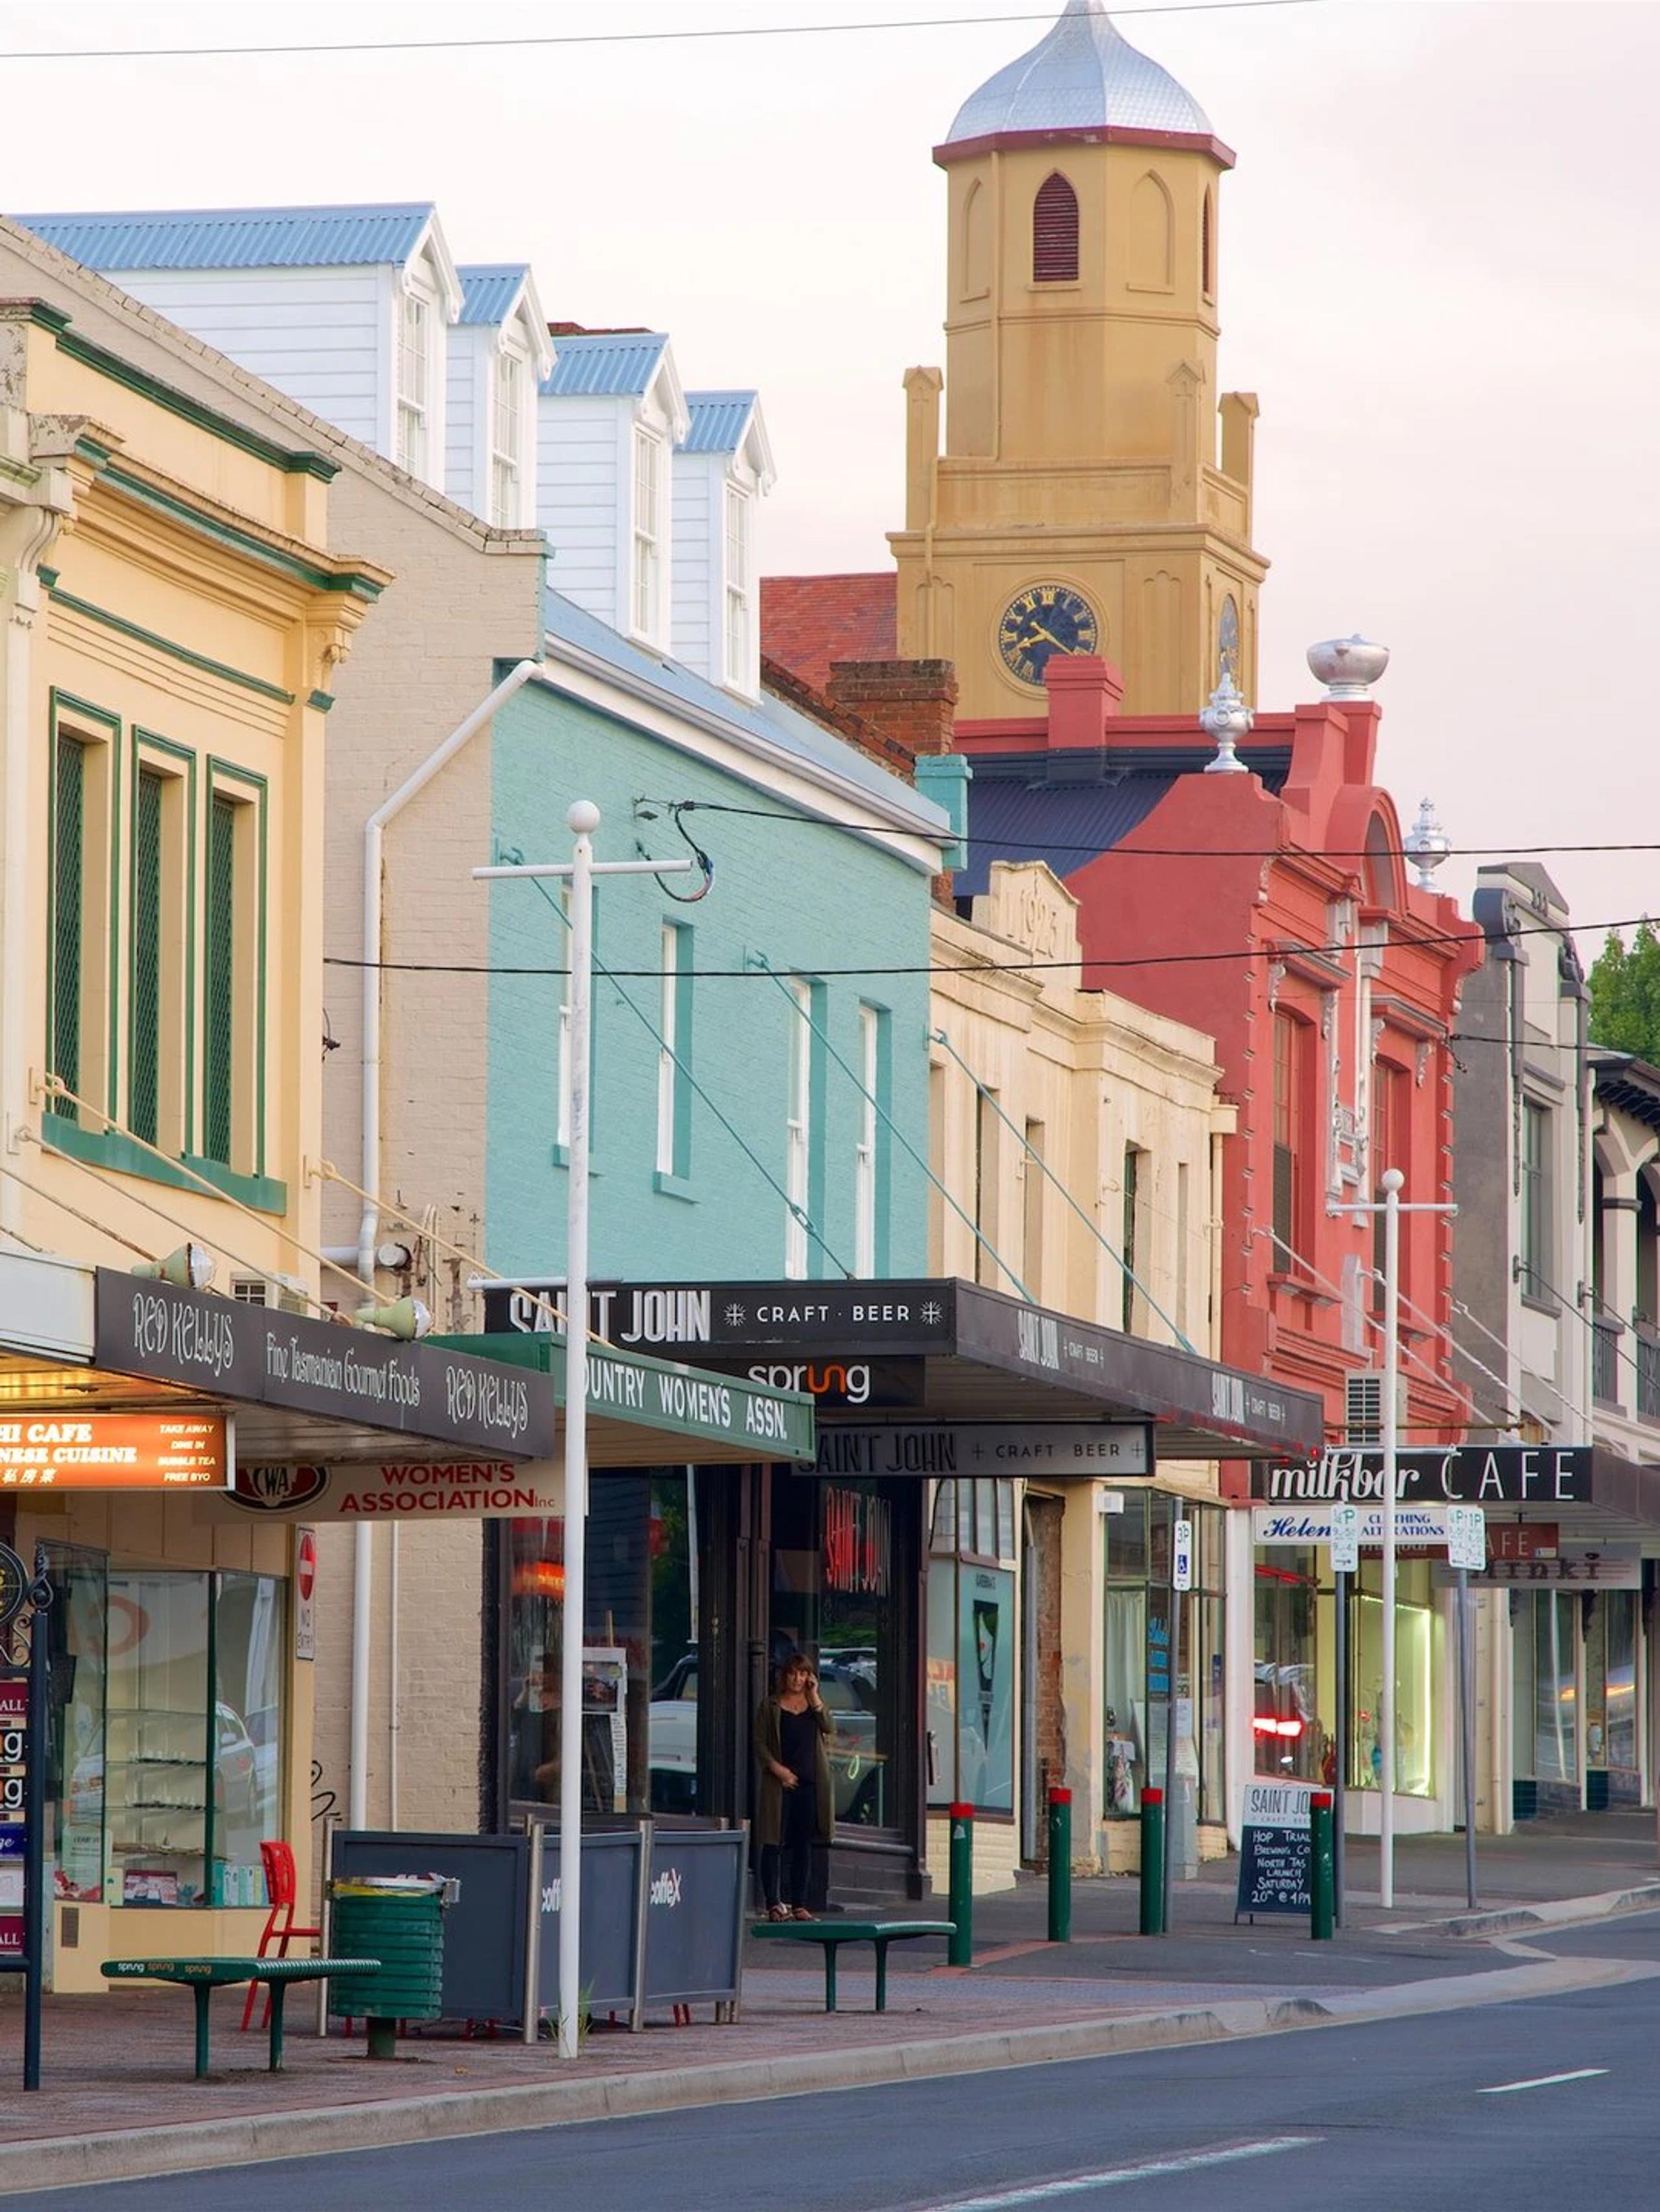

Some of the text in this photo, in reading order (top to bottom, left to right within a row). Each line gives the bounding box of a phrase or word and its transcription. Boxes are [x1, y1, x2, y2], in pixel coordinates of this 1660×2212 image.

[510, 1290, 710, 1342] SAIT JOHN
[756, 1304, 910, 1323] CRAFT BEER
[290, 1335, 342, 1391] Tasmanian
[388, 1358, 421, 1407] Foods
[748, 1364, 870, 1404] sprung
[658, 1373, 731, 1428] WOMEN'S
[27, 1424, 92, 1442] CAFE
[185, 1424, 215, 1434] AWAY
[53, 1447, 137, 1463] CUISINE
[798, 1432, 958, 1473] AINT JOHN
[995, 1443, 1120, 1459] CRAFT BEER
[381, 1463, 515, 1485] WOMEN'S
[1441, 1451, 1576, 1499] CAFE
[338, 1488, 555, 1512] ASSOCIATION Inc
[1369, 1514, 1430, 1524] CLTHING
[1362, 1525, 1445, 1535] ALTRATIONS
[1251, 1788, 1310, 1815] SAINT JO
[1252, 1830, 1274, 1843] HOP
[1256, 1876, 1305, 1891] SATURDAY
[118, 1962, 145, 1973] sprung
